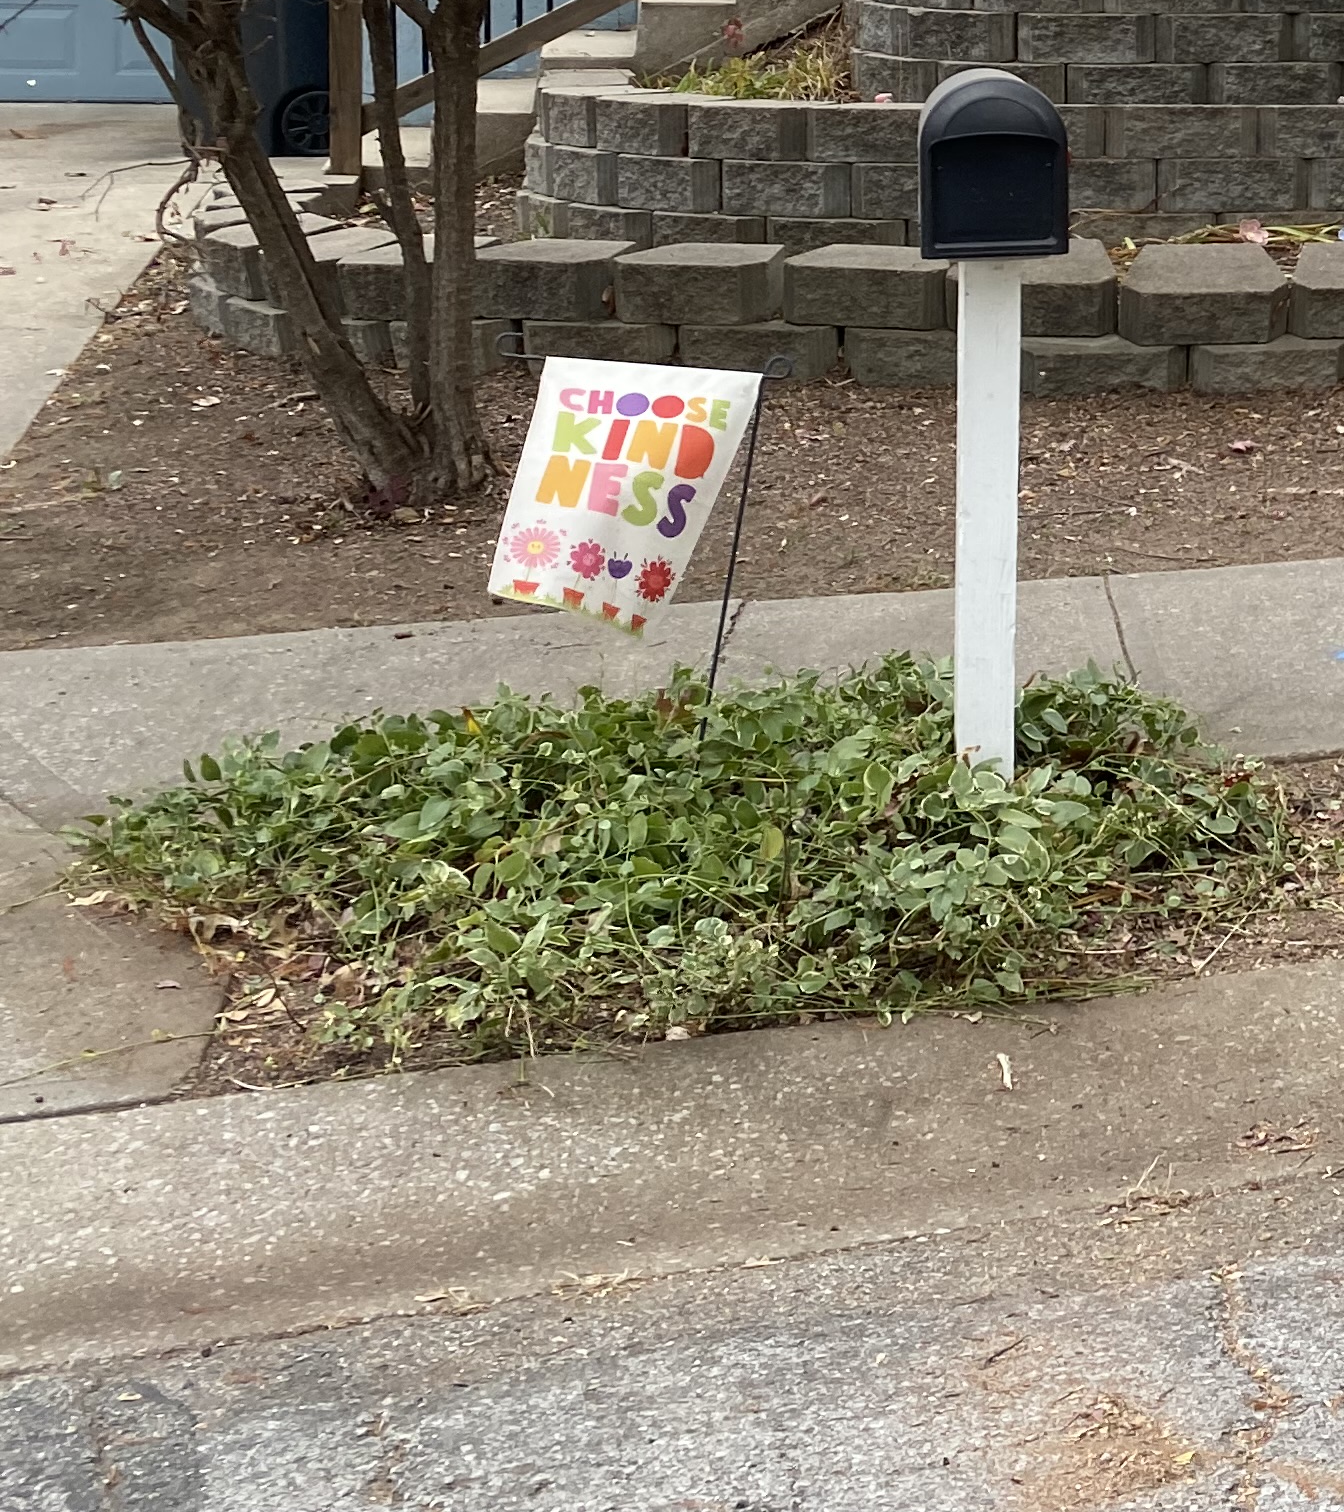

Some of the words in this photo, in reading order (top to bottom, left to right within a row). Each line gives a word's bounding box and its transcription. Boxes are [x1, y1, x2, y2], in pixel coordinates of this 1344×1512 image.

[559, 388, 731, 431] CHOOSE
[552, 411, 715, 479] KIND
[535, 455, 697, 538] NESS
